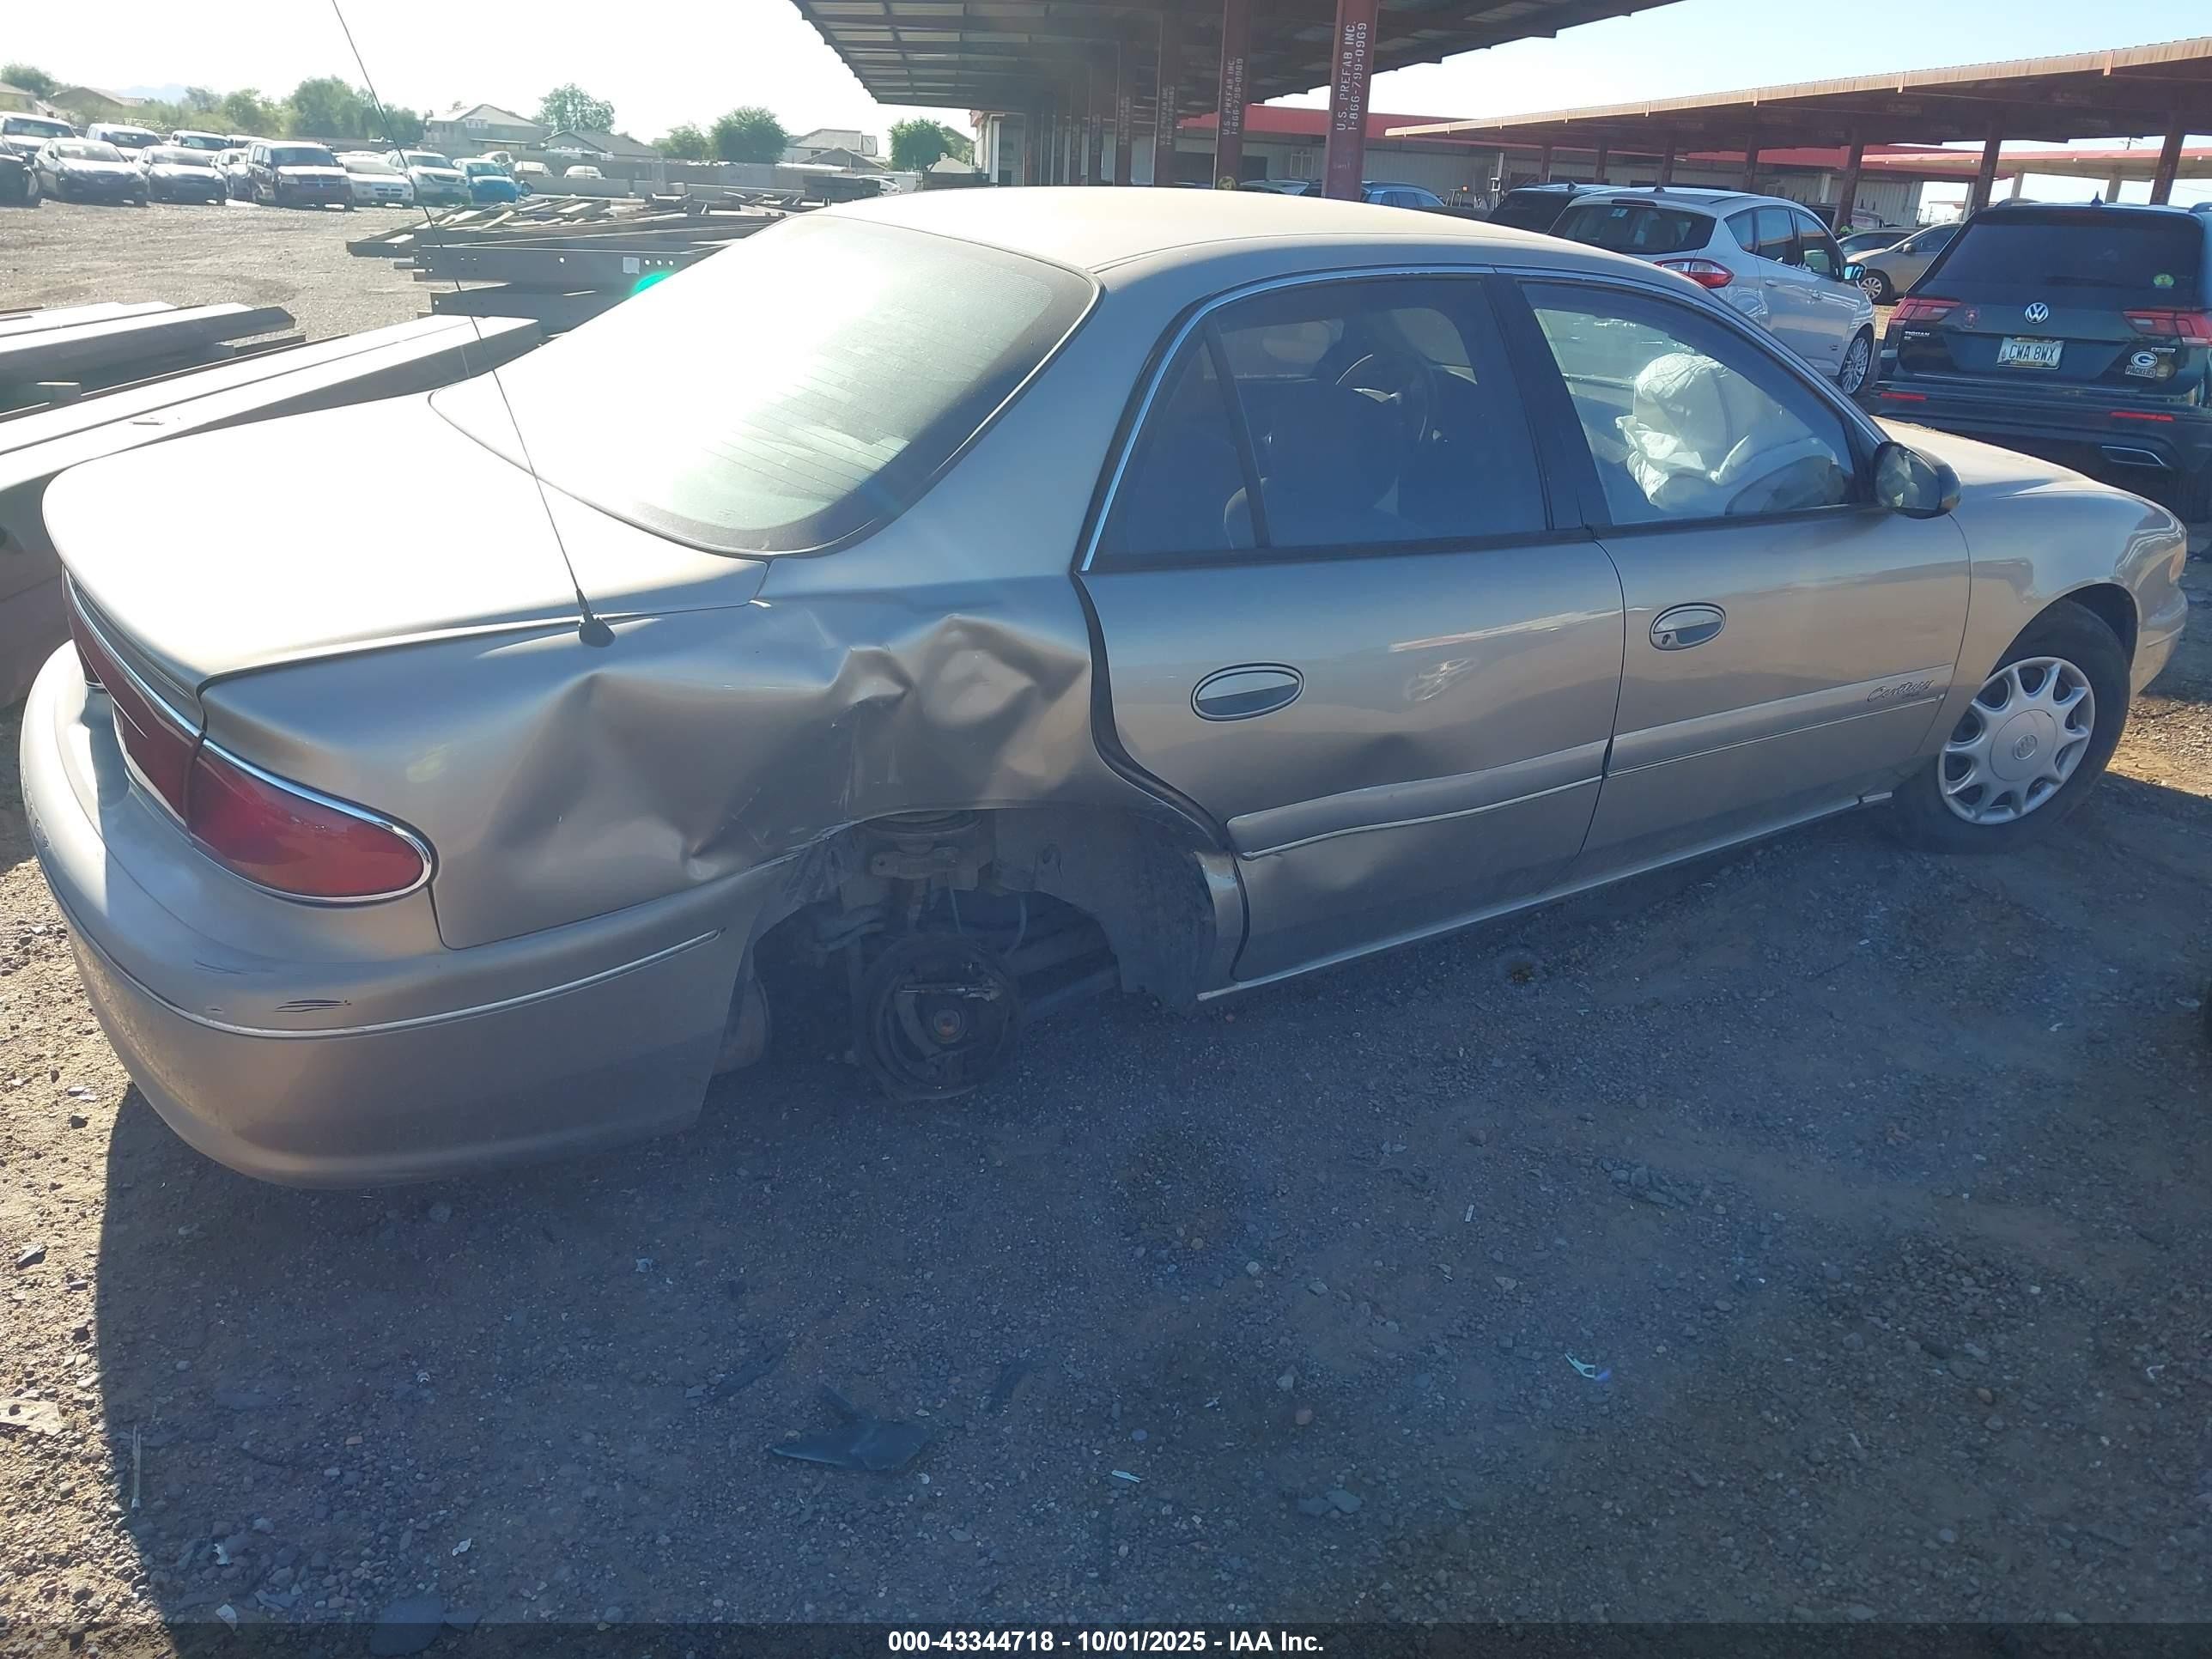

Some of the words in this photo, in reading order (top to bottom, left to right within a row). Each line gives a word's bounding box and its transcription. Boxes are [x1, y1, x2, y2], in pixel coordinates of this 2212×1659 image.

[1344, 21, 1357, 45] INC.
[1340, 52, 1353, 100] PREFAB
[1347, 22, 1367, 130] 1-866-799-0969
[1336, 107, 1347, 131] U.S.
[2008, 344, 2031, 360] CWA
[2033, 346, 2056, 362] 8WX
